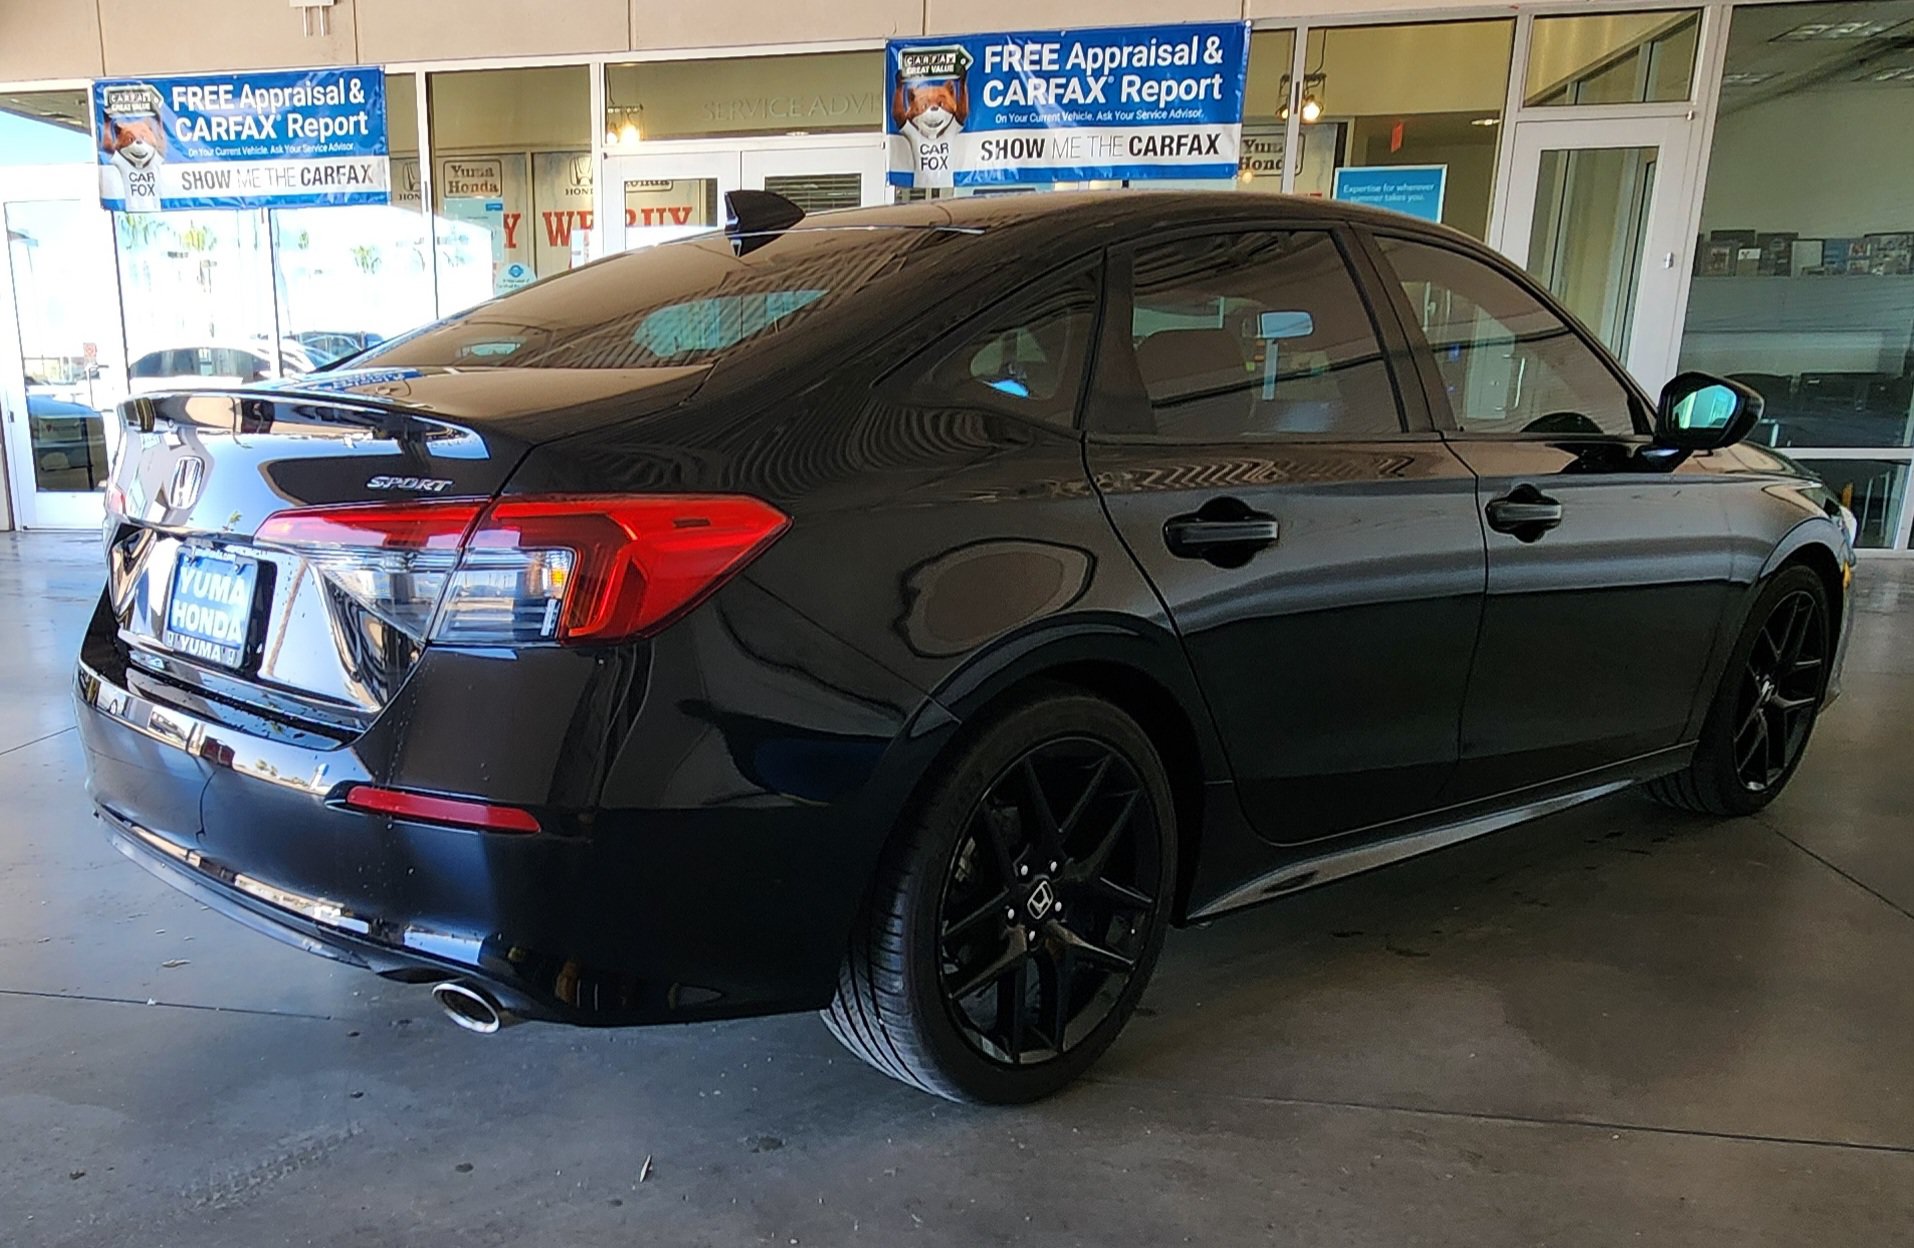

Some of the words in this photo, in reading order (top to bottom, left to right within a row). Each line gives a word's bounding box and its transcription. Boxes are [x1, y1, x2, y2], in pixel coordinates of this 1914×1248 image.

[905, 53, 956, 66] CARFAX
[984, 42, 1060, 73] FREE
[1065, 35, 1198, 75] Appraisal
[1202, 36, 1223, 64] &
[906, 66, 929, 74] GREAT
[931, 65, 954, 73] VALUE
[171, 84, 234, 112] FREE
[240, 78, 345, 114] Appraisal
[349, 78, 365, 103] &
[1121, 73, 1223, 108] Report
[703, 96, 803, 121] SERVICE
[808, 92, 883, 118] ADVI
[995, 114, 1007, 124] On
[1008, 113, 1028, 123] Your
[1030, 112, 1060, 123] Current
[1062, 111, 1095, 122] Vehicle.
[1096, 110, 1112, 121] Ask
[1114, 110, 1134, 120] Your
[1136, 109, 1167, 120] Service
[287, 111, 369, 143] Report
[188, 148, 198, 157] On
[198, 147, 214, 156] Your
[215, 147, 241, 156] Current
[270, 145, 284, 154] Ask
[284, 144, 302, 153] Your
[303, 143, 328, 153] Service
[920, 142, 949, 156] CAR
[981, 138, 1045, 161] SHOW
[1052, 137, 1081, 160] ME
[1086, 135, 1123, 159] THE
[1129, 133, 1220, 157] CARFAX
[921, 156, 948, 171] FOX
[128, 171, 155, 183] CAR
[181, 169, 231, 191] SHOW
[236, 168, 261, 188] ME
[265, 166, 296, 188] THE
[300, 164, 374, 187] CARFAX
[451, 165, 495, 179] Yuma
[130, 184, 156, 197] FOX
[448, 180, 499, 194] Honda
[1383, 183, 1395, 193] for
[366, 475, 456, 493] SPORT
[180, 565, 246, 606] YUMA
[171, 599, 243, 645] HONDA
[181, 635, 221, 662] YUMA
